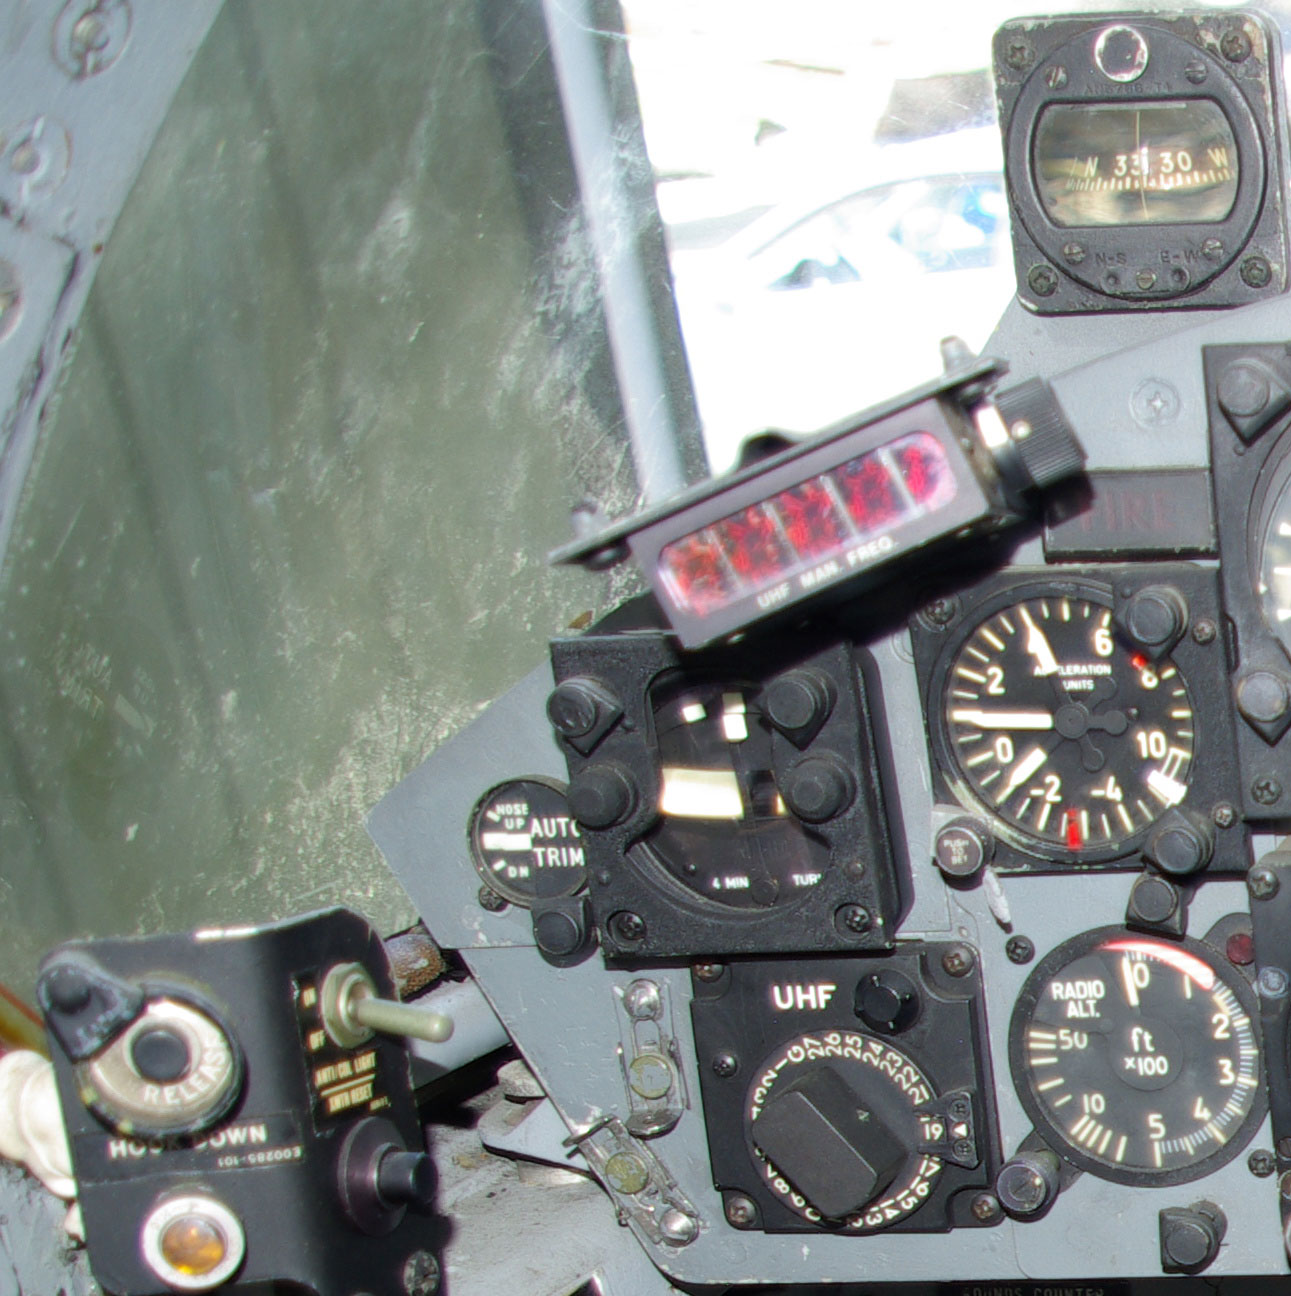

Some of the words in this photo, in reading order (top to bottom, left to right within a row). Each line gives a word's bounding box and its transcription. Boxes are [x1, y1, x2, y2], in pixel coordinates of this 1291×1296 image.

[756, 584, 792, 610] UHF
[1063, 680, 1094, 690] UNITS
[496, 804, 528, 815] NOSE
[505, 819, 526, 830] UP
[507, 866, 528, 878] DN
[773, 984, 836, 1009] UHF
[1052, 980, 1104, 1000] RADIO
[1067, 1000, 1101, 1018] ALT.
